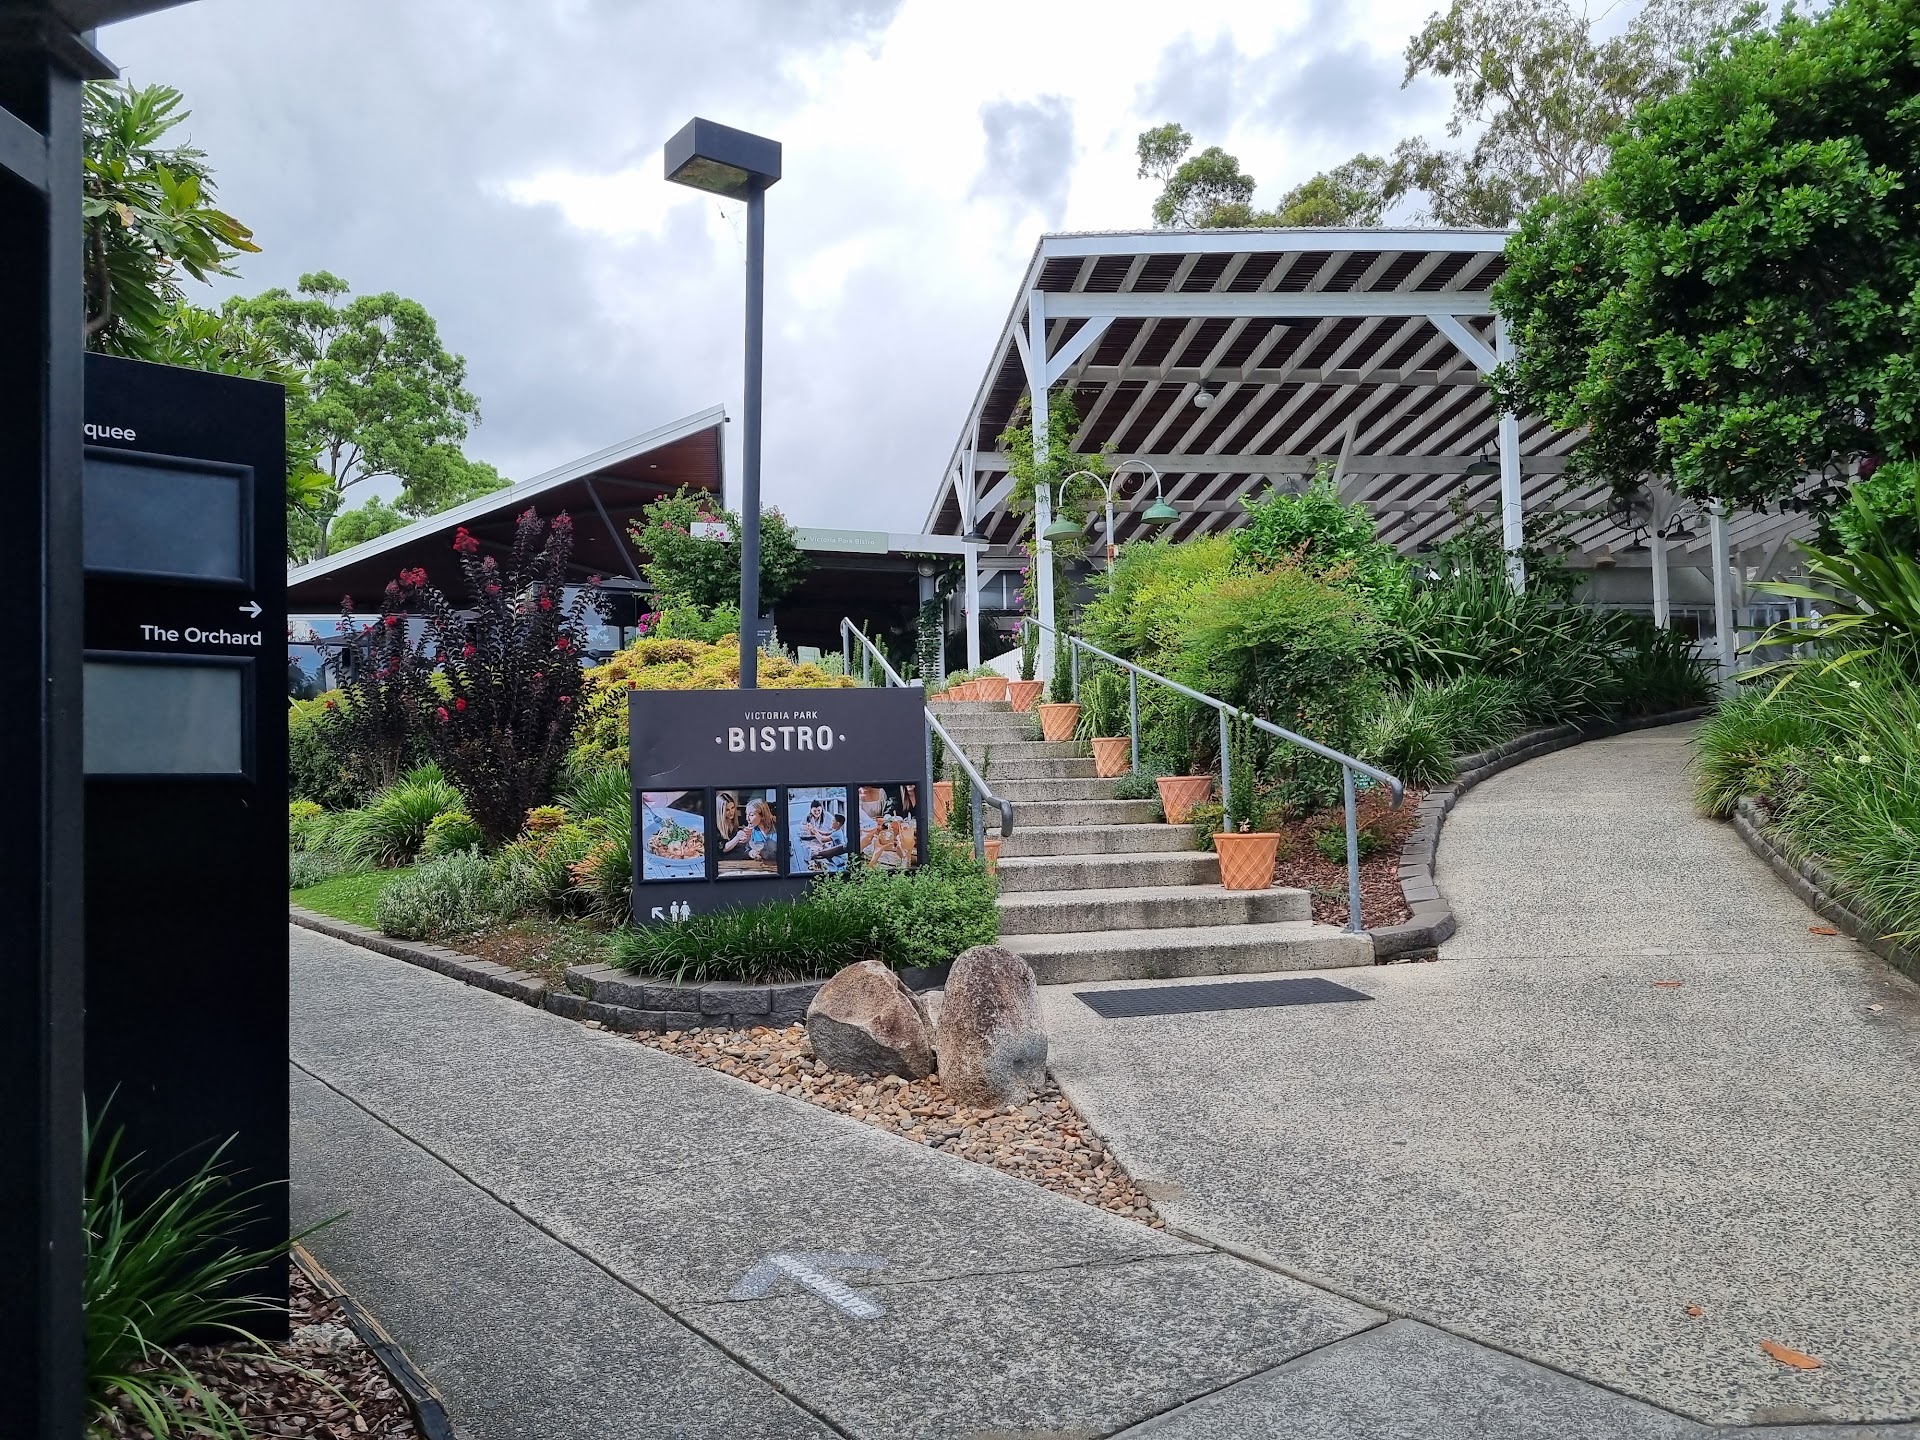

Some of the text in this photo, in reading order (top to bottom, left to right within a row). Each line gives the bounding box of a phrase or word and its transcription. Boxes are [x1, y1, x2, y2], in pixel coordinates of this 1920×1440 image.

[83, 423, 137, 441] quee
[140, 624, 262, 646] The Orchard
[744, 710, 818, 720] VICTORIA PARK
[728, 725, 834, 753] BISTRO
[769, 1254, 879, 1316] BATHROOMS
